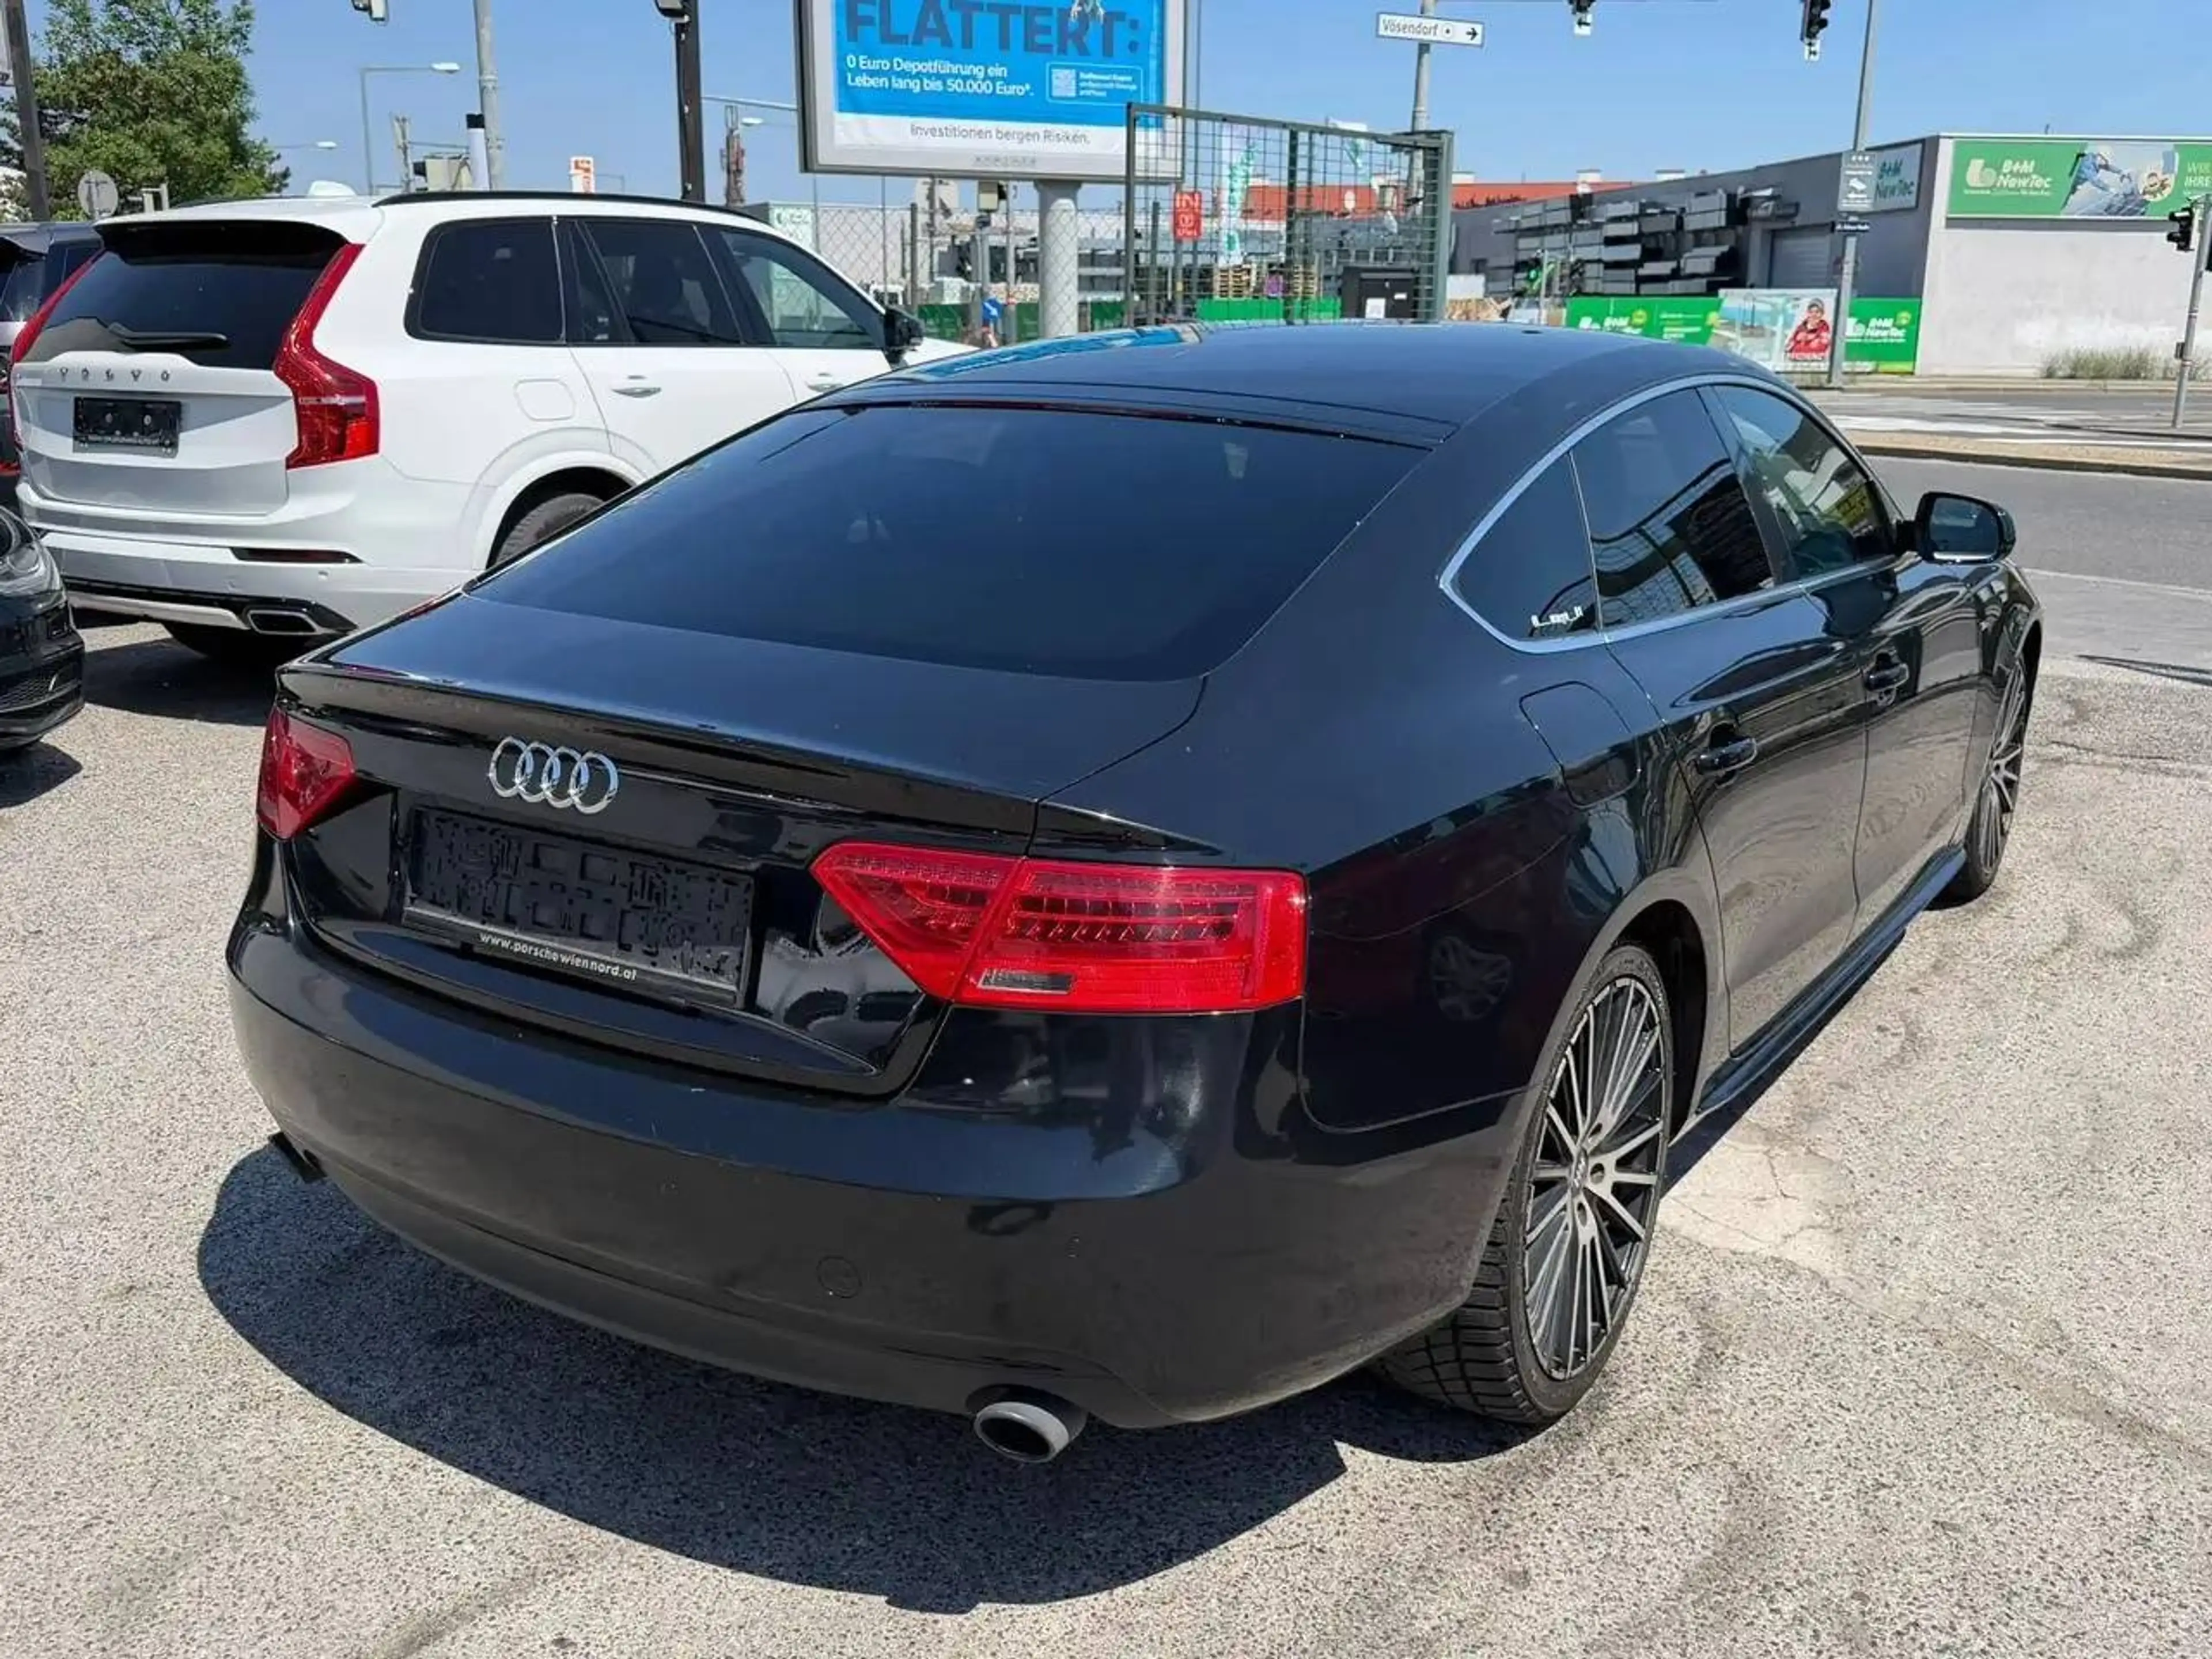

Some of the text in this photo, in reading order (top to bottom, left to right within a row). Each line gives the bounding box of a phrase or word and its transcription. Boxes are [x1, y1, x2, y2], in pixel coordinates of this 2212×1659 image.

[846, 0, 1139, 57] FLATTERT:
[1382, 19, 1439, 36] Vösendorf
[846, 55, 1007, 78] 0 Euro Depotführung ein
[847, 73, 888, 88] Leben
[892, 75, 921, 92] lang
[925, 78, 943, 91] bis
[946, 79, 993, 94] 50.000
[910, 124, 1091, 145] Investitionen bergen Risiken.
